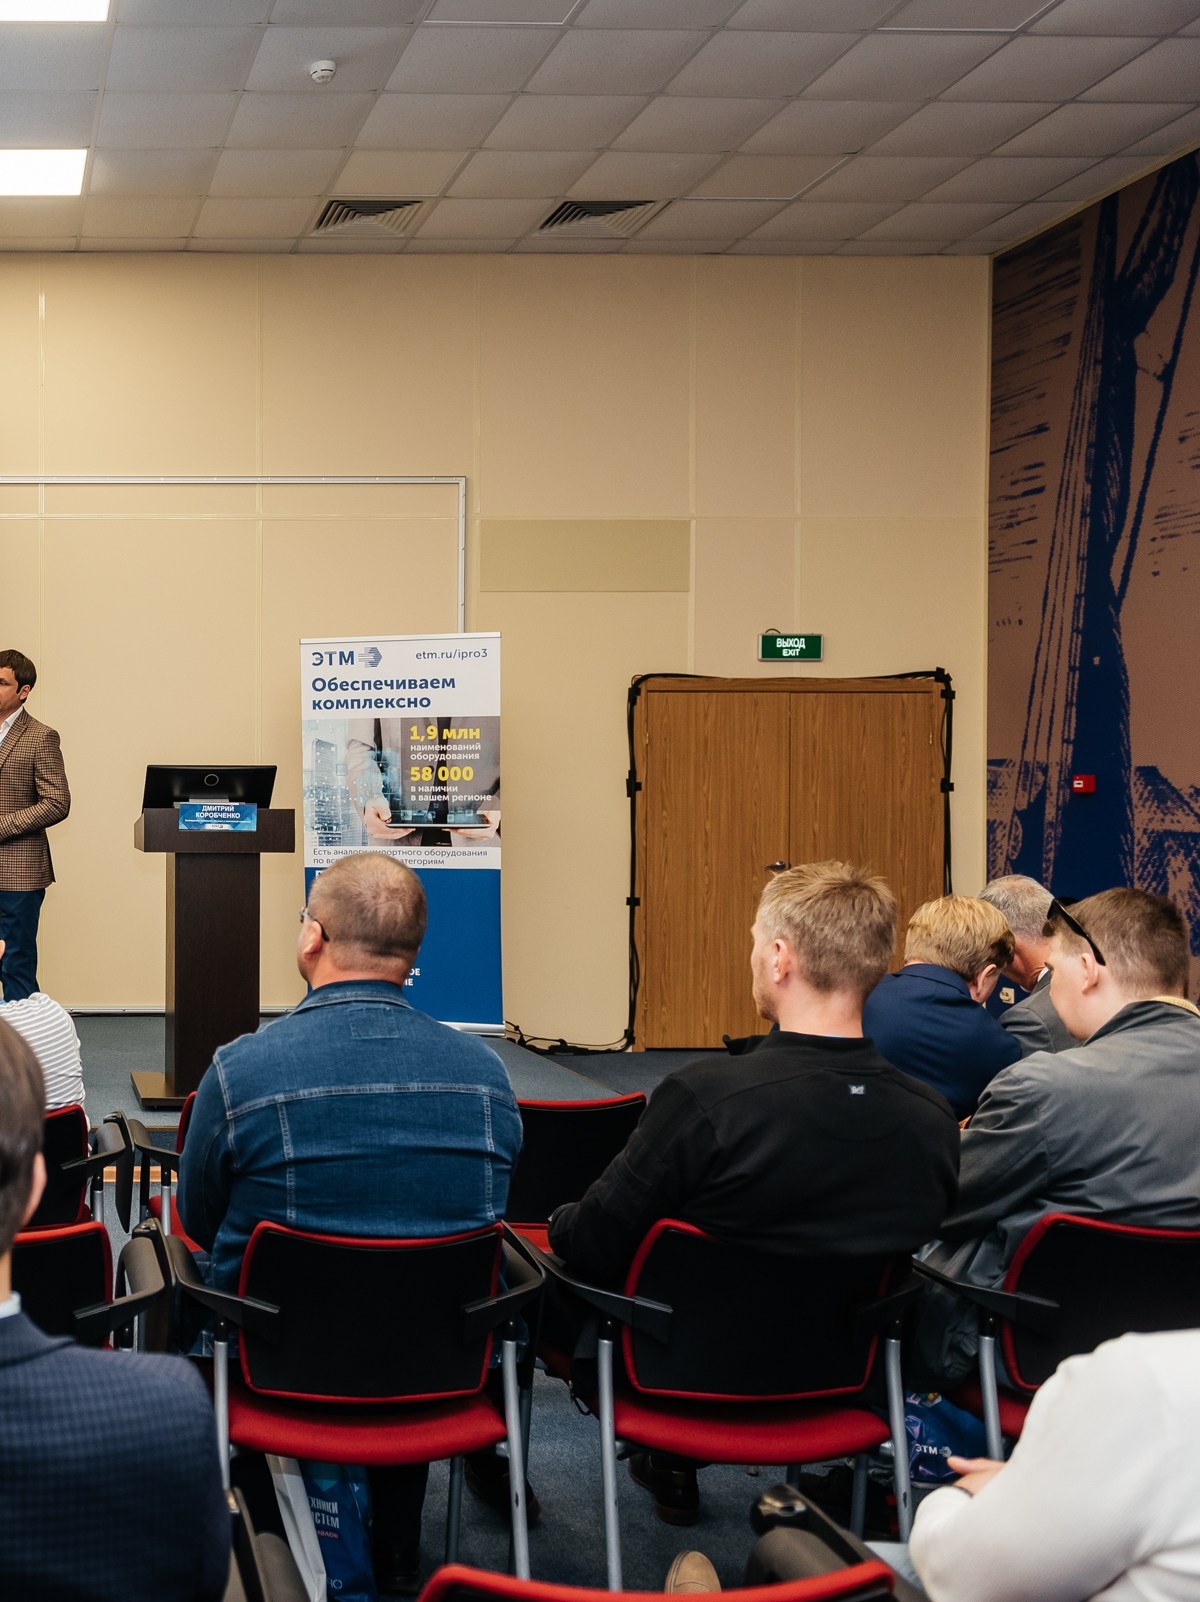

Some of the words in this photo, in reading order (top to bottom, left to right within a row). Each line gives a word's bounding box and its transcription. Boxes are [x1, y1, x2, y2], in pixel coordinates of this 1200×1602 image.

[776, 638, 806, 649] ВЫХОД
[312, 651, 355, 666] ЭТМ
[415, 649, 488, 660] etm.ru/ipro3
[312, 677, 456, 692] Обеспечиваем
[312, 697, 431, 710] комплексно
[410, 725, 438, 742] 1,9
[443, 728, 480, 739] млн
[410, 743, 481, 751] наименований
[410, 752, 480, 761] оборудования
[410, 766, 433, 781] 58
[438, 766, 474, 781] 000
[452, 794, 492, 803] регионе
[424, 849, 488, 858] оборудования
[915, 1444, 938, 1455] ЭТМ
